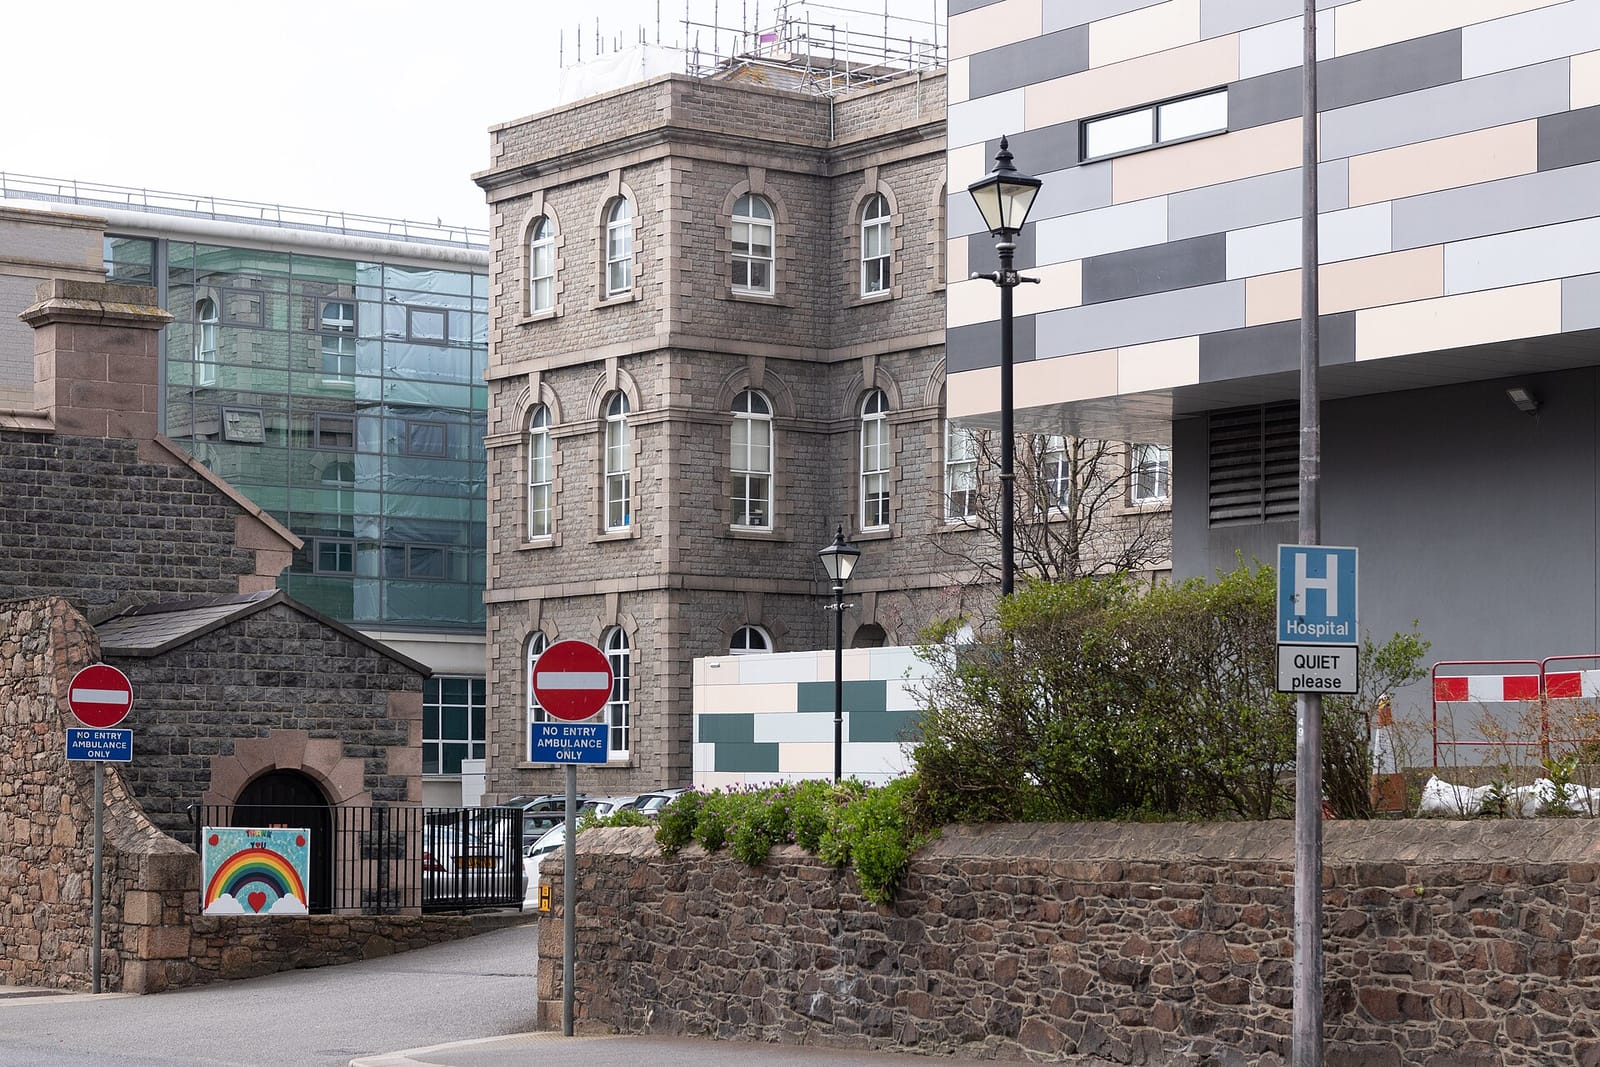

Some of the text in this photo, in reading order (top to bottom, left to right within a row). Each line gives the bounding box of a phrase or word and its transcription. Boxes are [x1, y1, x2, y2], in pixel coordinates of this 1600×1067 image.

[1294, 552, 1338, 616] H
[1287, 620, 1349, 638] Hospital
[1293, 654, 1340, 670] QUIET
[1292, 673, 1342, 691] please
[76, 731, 122, 740] NO ENTRY
[542, 726, 597, 737] NO ENTRY
[72, 740, 127, 749] AMBULANCE
[537, 738, 602, 748] AMBULANCE
[87, 750, 110, 758] ONLY
[555, 750, 583, 760] ONLY
[245, 829, 272, 838] THANK
